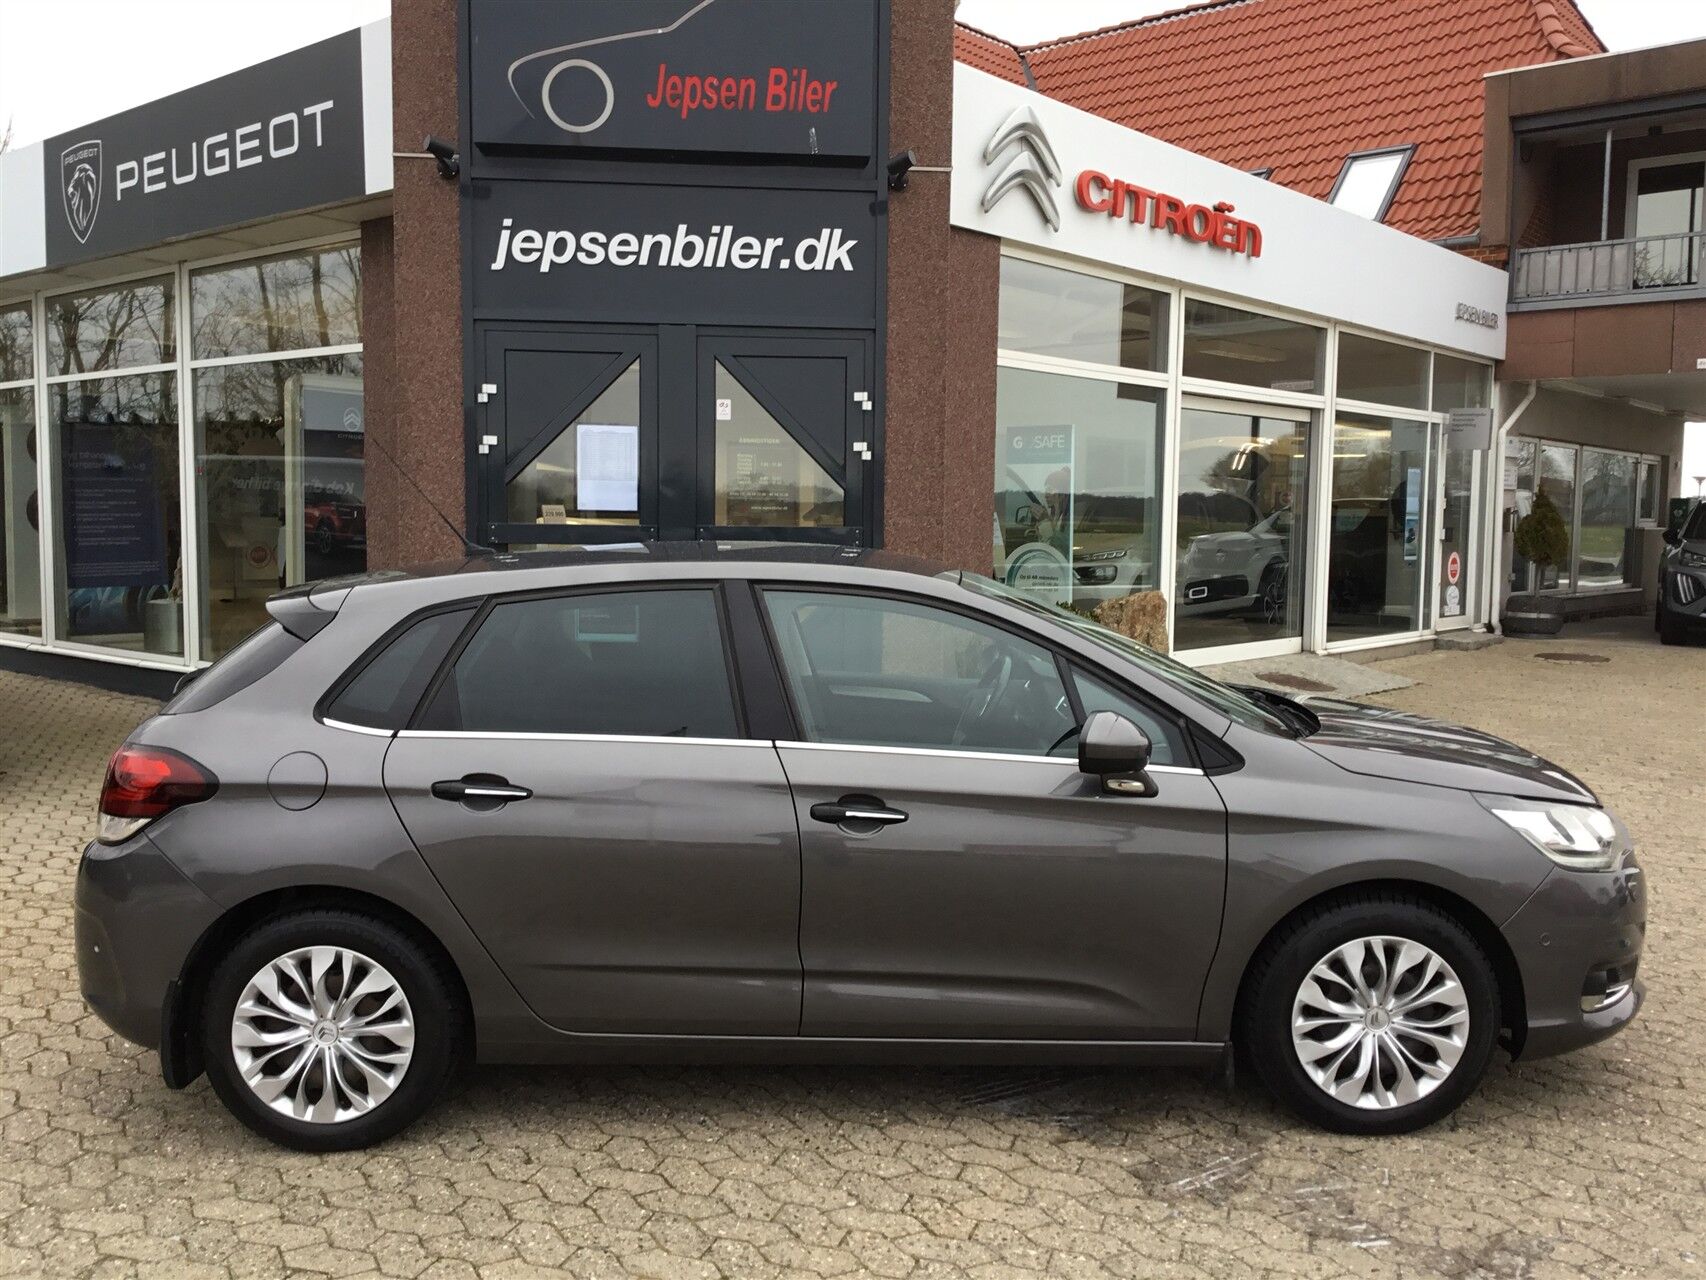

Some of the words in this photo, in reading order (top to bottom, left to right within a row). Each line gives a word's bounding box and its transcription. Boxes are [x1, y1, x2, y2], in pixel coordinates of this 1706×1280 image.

[646, 63, 756, 119] Jepsen
[765, 67, 838, 114] Biler
[64, 148, 98, 167] PEUGEOT
[116, 100, 334, 201] PEUGEOT
[490, 218, 859, 273] jepsenbiler.dk
[1033, 434, 1065, 449] SAFE
